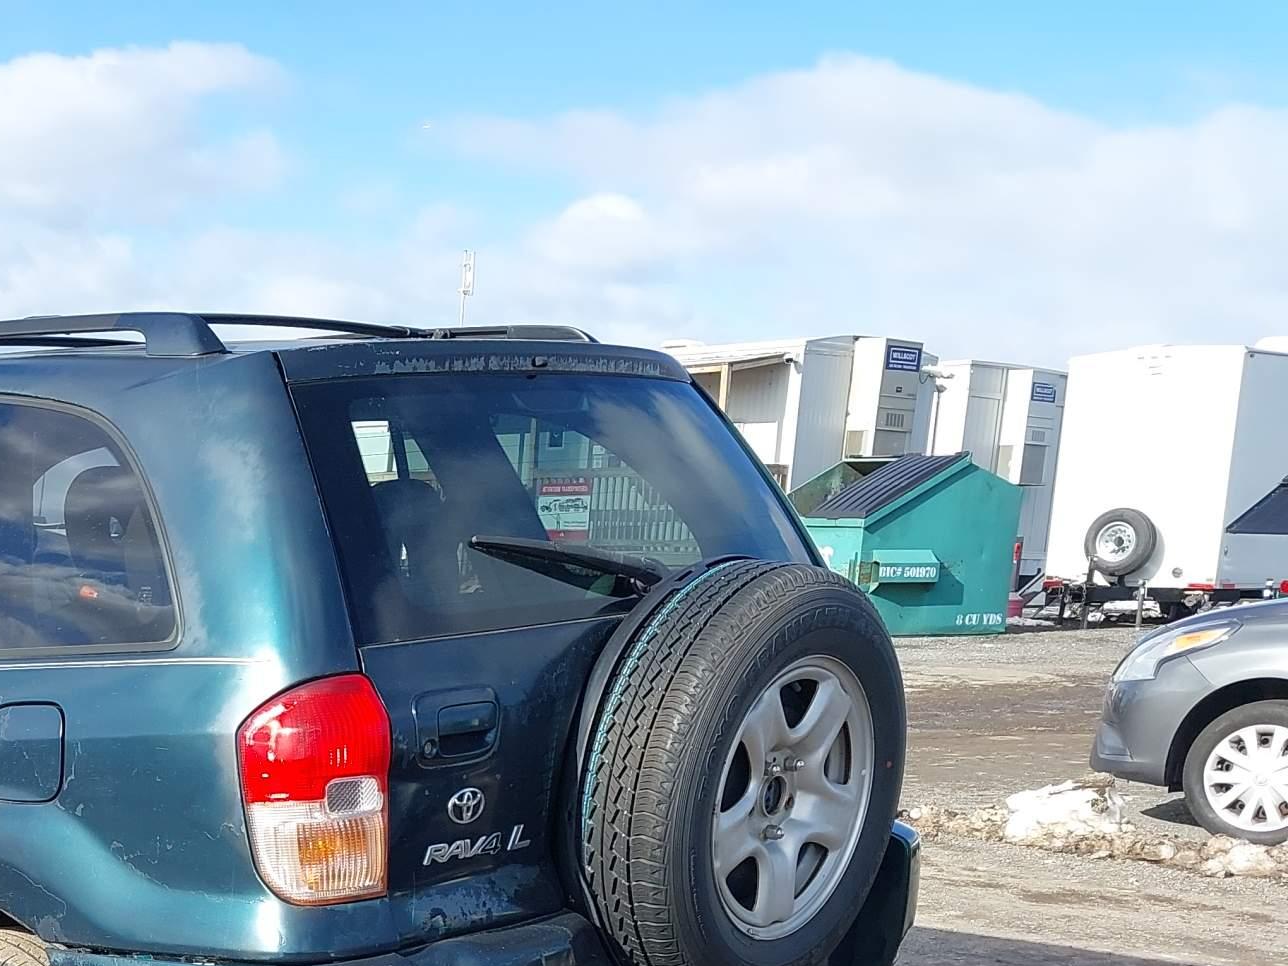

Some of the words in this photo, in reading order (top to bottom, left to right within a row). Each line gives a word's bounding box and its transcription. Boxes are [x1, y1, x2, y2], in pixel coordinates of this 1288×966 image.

[903, 566, 937, 578] 501970
[955, 614, 964, 626] 8
[965, 613, 981, 626] CU
[982, 613, 1003, 625] YDS
[423, 832, 502, 866] RAV4
[507, 824, 531, 851] L
